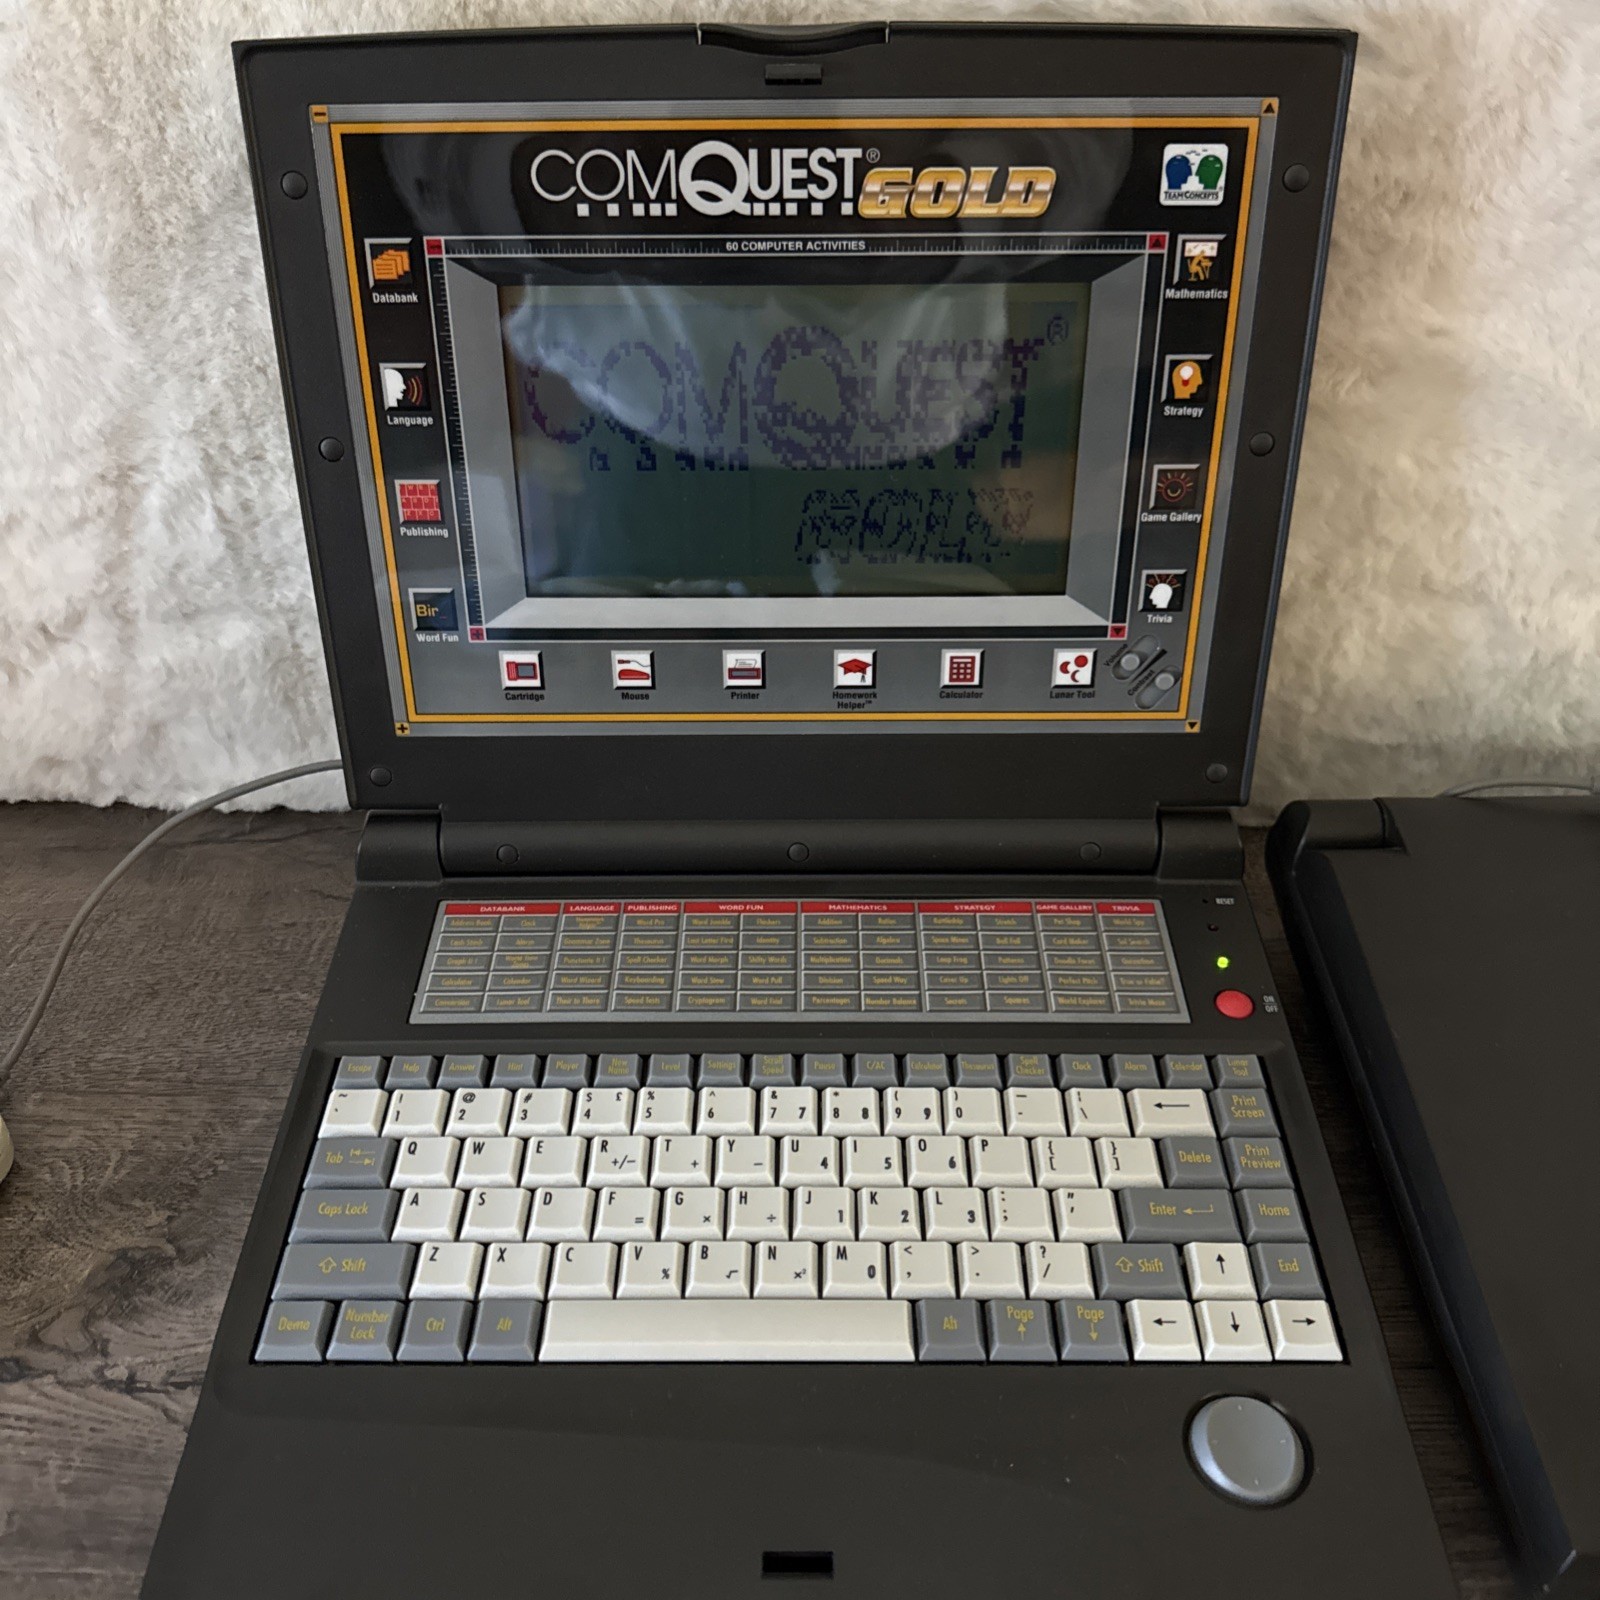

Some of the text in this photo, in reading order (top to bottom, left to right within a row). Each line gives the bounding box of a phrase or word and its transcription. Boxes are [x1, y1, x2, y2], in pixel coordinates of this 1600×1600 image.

[858, 166, 1057, 218] GOLD
[726, 240, 866, 251] 60 COMPUTER ACTIVITIES
[373, 292, 418, 304] Databank
[1165, 288, 1228, 299] Mathematics
[1163, 406, 1203, 418] Strategy
[387, 415, 433, 427] Language
[1141, 512, 1201, 523] Game Gallery
[400, 527, 449, 538] Publishing
[1147, 614, 1173, 623] Trivia
[416, 633, 459, 642] Word Fun
[1127, 670, 1155, 696] Contrast
[505, 692, 544, 701] Cartridge
[622, 692, 649, 700] Mouse
[731, 692, 760, 700] Printer
[832, 691, 877, 700] Homework
[939, 690, 983, 699] Calculator
[1050, 690, 1095, 699] Lunar Tool
[347, 1063, 371, 1073] Escape
[403, 1063, 420, 1073] Help
[449, 1063, 476, 1071] Answer
[508, 1063, 522, 1071] Hint
[555, 1061, 579, 1071] Player
[608, 1066, 629, 1074] Name
[661, 1062, 680, 1071] Level
[707, 1061, 736, 1071] Settings
[762, 1064, 784, 1075] Speed
[814, 1061, 835, 1071] Pause
[866, 1061, 885, 1070] C/AC
[1016, 1065, 1045, 1075] Checker
[1072, 1062, 1092, 1071] Clock
[1124, 1062, 1147, 1071] Alarm
[1170, 1062, 1203, 1071] Calendar
[1232, 1095, 1256, 1106] Print
[396, 1111, 400, 1121] 1
[459, 1109, 466, 1120] 2
[521, 1109, 527, 1120] 3
[584, 1109, 590, 1119] 4
[646, 1108, 651, 1118] 5
[708, 1108, 714, 1118] 6
[771, 1107, 806, 1119] 7 7
[833, 1108, 869, 1119] 8 8
[895, 1107, 931, 1119] 9 9
[1231, 1107, 1265, 1118] Screen
[408, 1142, 417, 1155] Q
[473, 1142, 485, 1154] W
[536, 1141, 543, 1153] E
[601, 1140, 608, 1152] R
[665, 1139, 671, 1151] T
[728, 1140, 735, 1152] Y
[792, 1140, 799, 1152] U
[981, 1139, 988, 1151] P
[1245, 1144, 1270, 1156] Print
[326, 1152, 343, 1164] Tab
[821, 1157, 828, 1169] 4
[885, 1157, 891, 1169] 5
[949, 1157, 956, 1169] 6
[1179, 1151, 1212, 1163] Delete
[1241, 1156, 1281, 1169] Preview
[410, 1193, 418, 1205] A
[479, 1192, 486, 1205] S
[543, 1192, 552, 1205] D
[609, 1192, 615, 1205] F
[675, 1192, 683, 1205] G
[740, 1191, 747, 1204] H
[806, 1191, 811, 1204] J
[870, 1192, 878, 1205] K
[936, 1191, 942, 1205] L
[318, 1202, 368, 1216] Caps Lock
[1150, 1202, 1177, 1216] Enter
[1258, 1204, 1290, 1216] Home
[838, 1210, 843, 1222] 1
[901, 1210, 909, 1223] 2
[968, 1210, 975, 1223] 3
[429, 1247, 439, 1261] Z
[497, 1248, 506, 1262] X
[566, 1247, 573, 1262] C
[635, 1246, 642, 1260] V
[701, 1245, 708, 1259] B
[768, 1246, 776, 1260] N
[837, 1246, 847, 1260] M
[340, 1259, 366, 1273] Shift
[1138, 1259, 1164, 1273] Shift
[1278, 1259, 1299, 1273] End
[345, 1310, 389, 1324] Number
[1007, 1306, 1034, 1323] Page
[1077, 1306, 1105, 1323] Page
[278, 1317, 310, 1331] Demo
[426, 1317, 445, 1332] Ctrl
[496, 1317, 512, 1332] Alt
[350, 1326, 375, 1340] Lock
